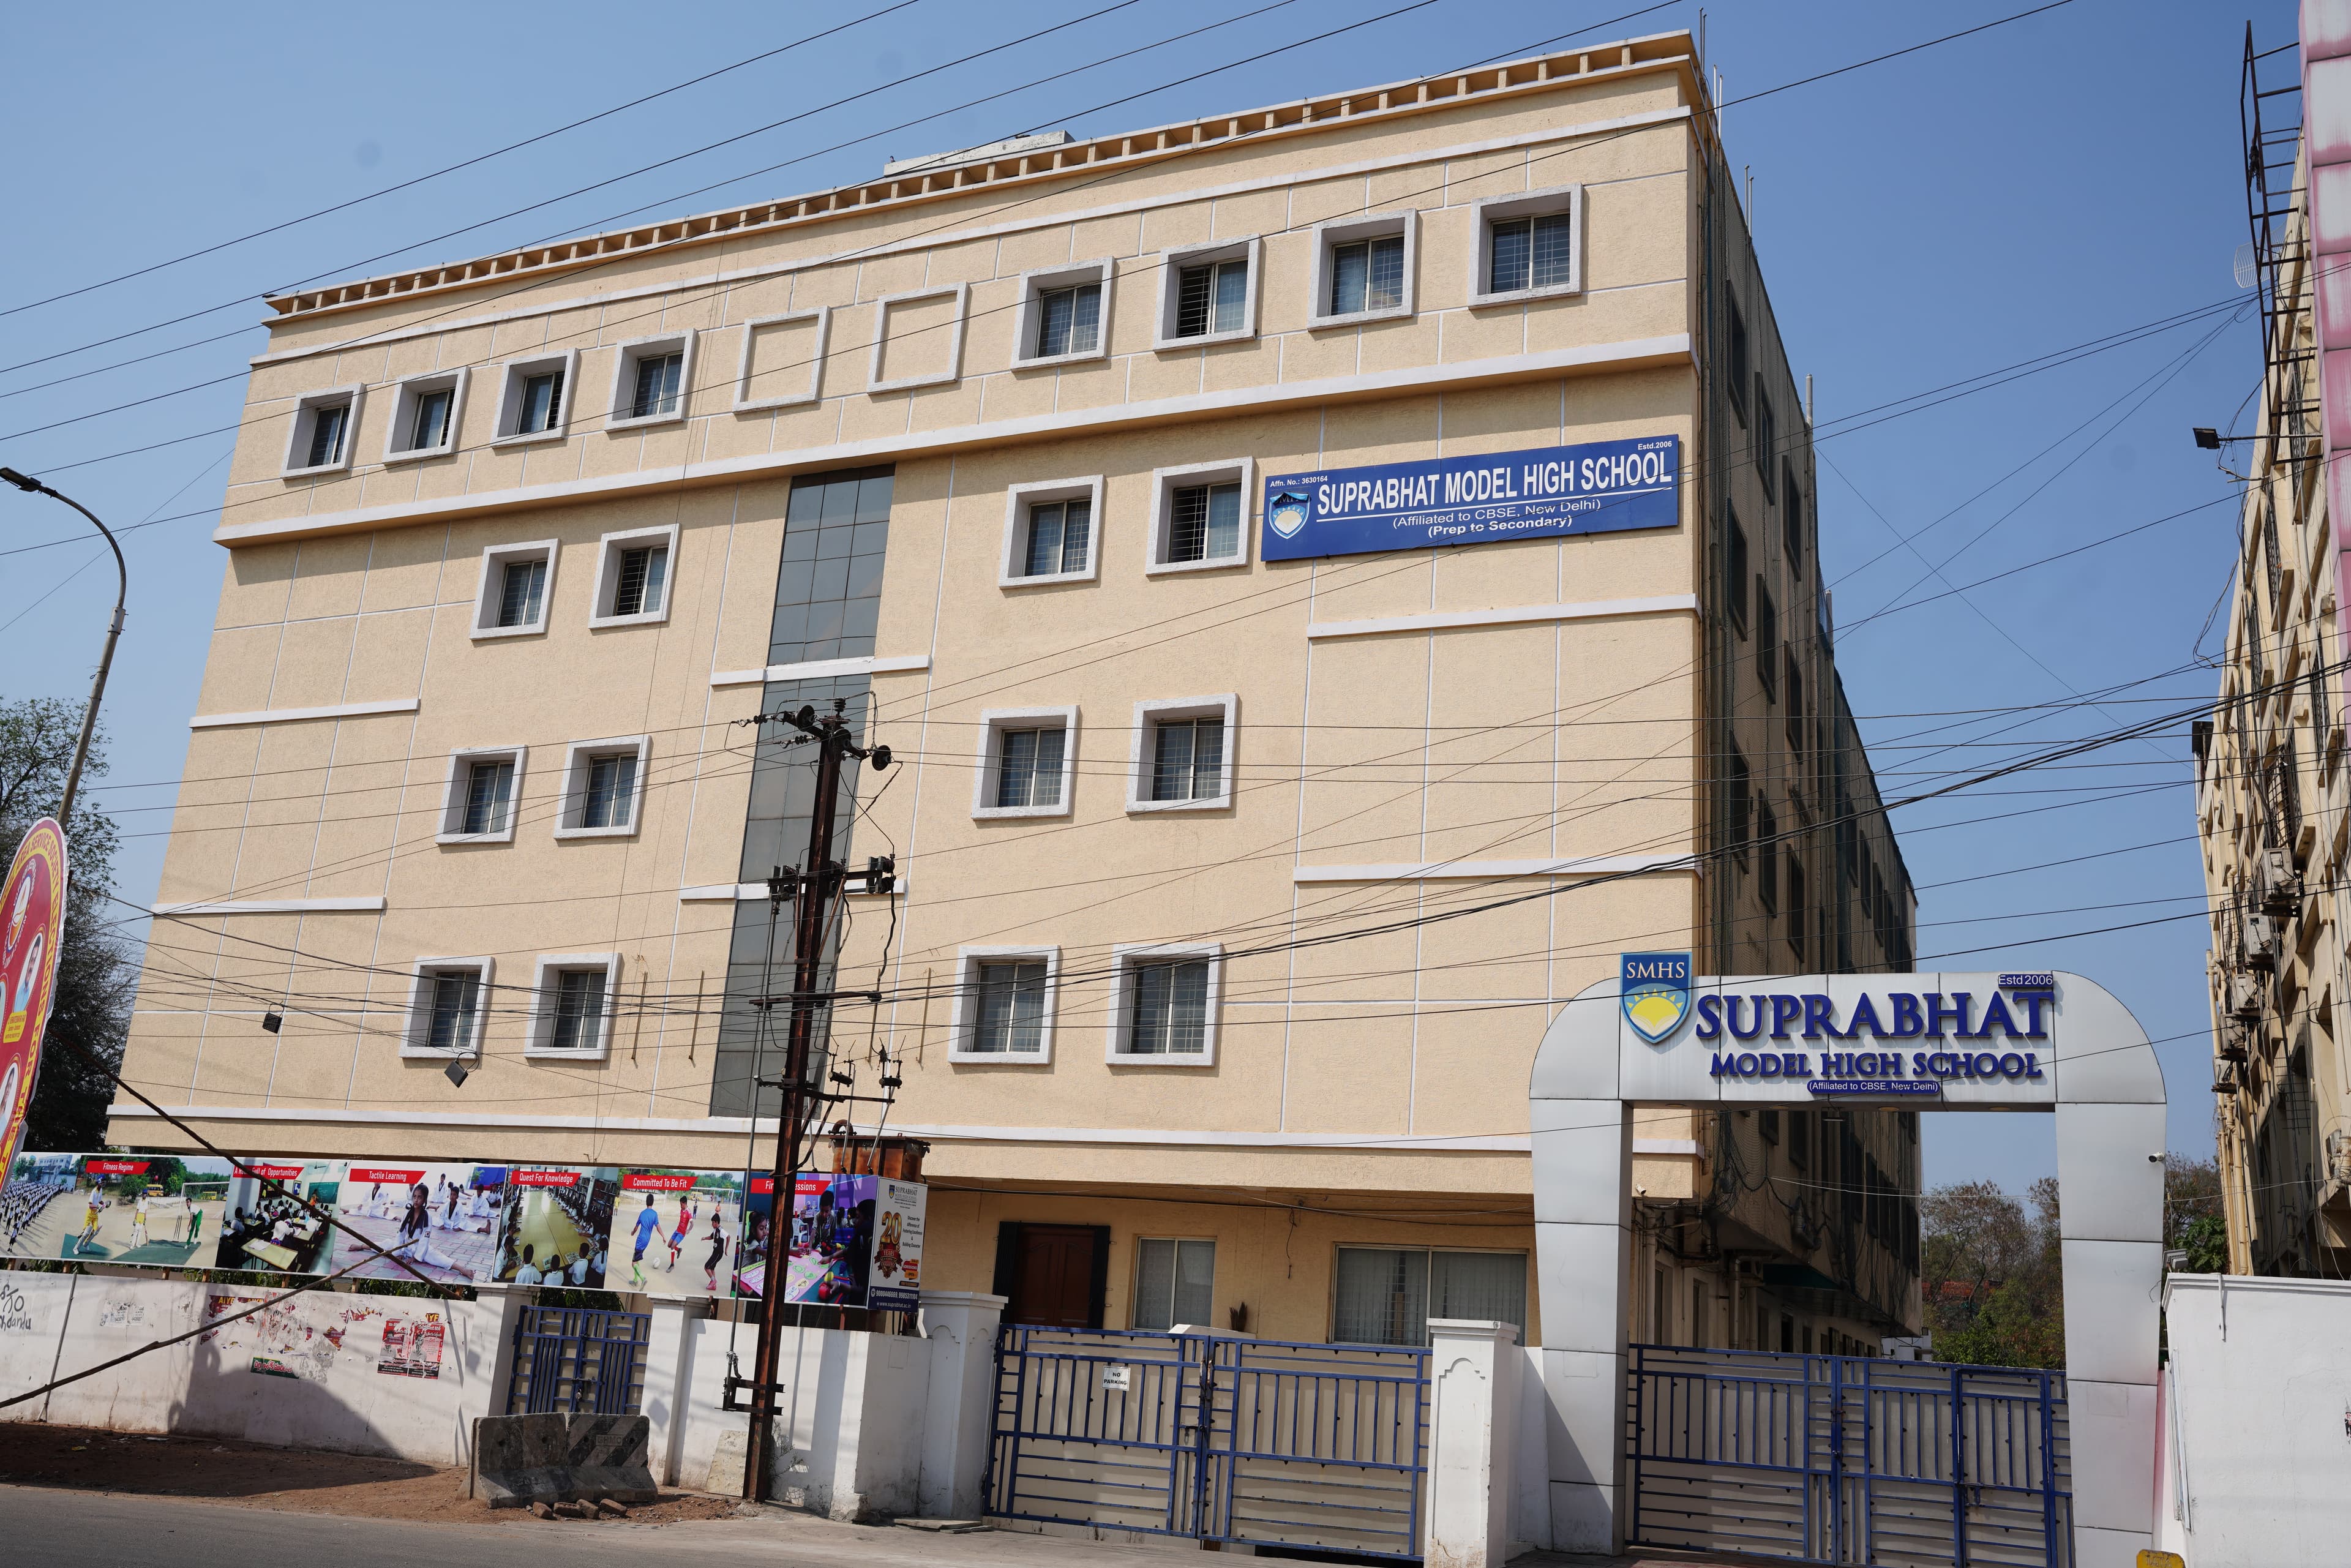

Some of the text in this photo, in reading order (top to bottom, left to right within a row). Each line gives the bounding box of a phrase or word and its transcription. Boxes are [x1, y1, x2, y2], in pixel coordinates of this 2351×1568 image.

[1637, 440, 1673, 451] Estd.2006
[1302, 475, 1328, 484] 3630164
[1318, 451, 1672, 515] SUPRABHAT MODEL HIGH SCHOOL
[1393, 499, 1601, 530] (Affiliated to CBSE, New Delhi)
[1428, 515, 1572, 538] (Prep to Secondary)
[1626, 961, 1685, 978] SMHS
[1696, 991, 2055, 1039] SUPRABHAT
[1709, 1052, 2042, 1078] MODEL HIGH SCHOOL
[1809, 1082, 1848, 1091] (Affiliated
[1860, 1082, 1889, 1091] CBSE,
[1913, 1082, 1938, 1091] Delhi)
[118, 1163, 133, 1172] Regime
[268, 1168, 298, 1177] Opportunities
[369, 1171, 407, 1182] Tactile Learning
[519, 1173, 534, 1182] Quest
[545, 1174, 573, 1185] Knowledge
[633, 1177, 663, 1187] Committed
[664, 1179, 670, 1187] To
[671, 1179, 678, 1188] Be
[765, 1180, 816, 1191] Fir essions
[895, 1187, 918, 1196] SUPRABHAT
[880, 1211, 902, 1245] 20
